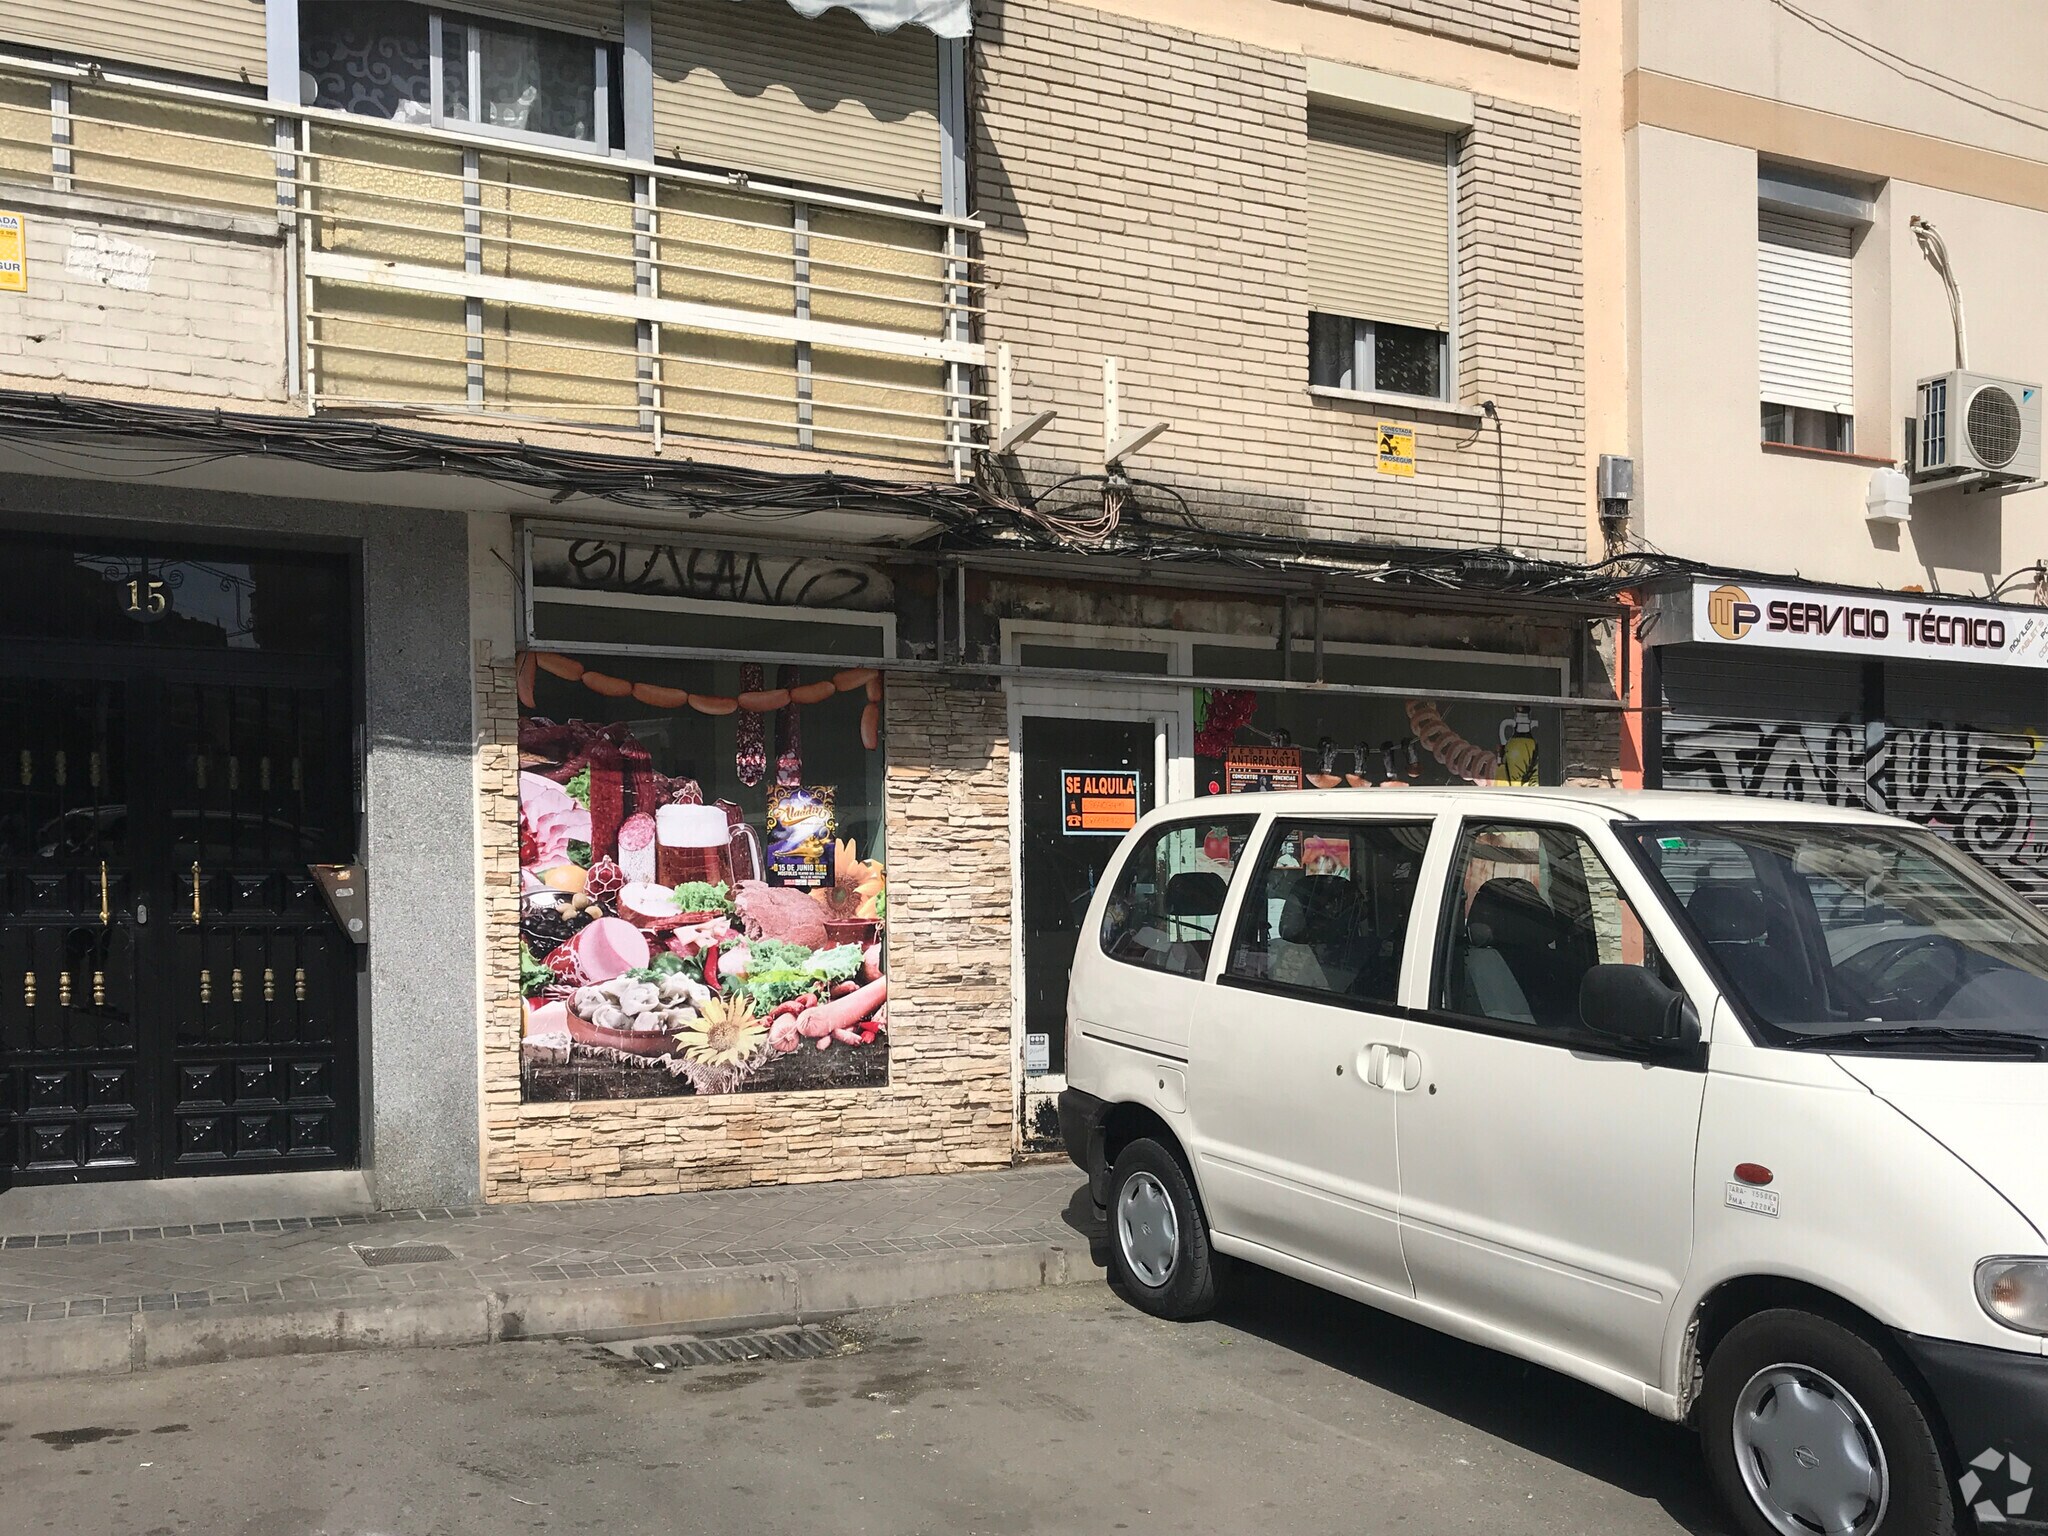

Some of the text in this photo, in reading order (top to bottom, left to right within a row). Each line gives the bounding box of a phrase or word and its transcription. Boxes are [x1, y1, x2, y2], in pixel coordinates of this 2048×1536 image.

[1380, 425, 1412, 434] CONECTADA
[1380, 454, 1413, 464] PROSEGUR
[126, 580, 166, 614] 15
[1766, 600, 1889, 640] SERVICIO
[1902, 608, 2006, 650] TÉCNICO
[2009, 618, 2034, 653] MOVILES
[1231, 748, 1297, 756] FESTIVAL
[1066, 776, 1135, 795] SE ALQUILA
[774, 804, 827, 823] Aladdin
[786, 864, 795, 872] DE
[796, 864, 814, 872] JUNIO
